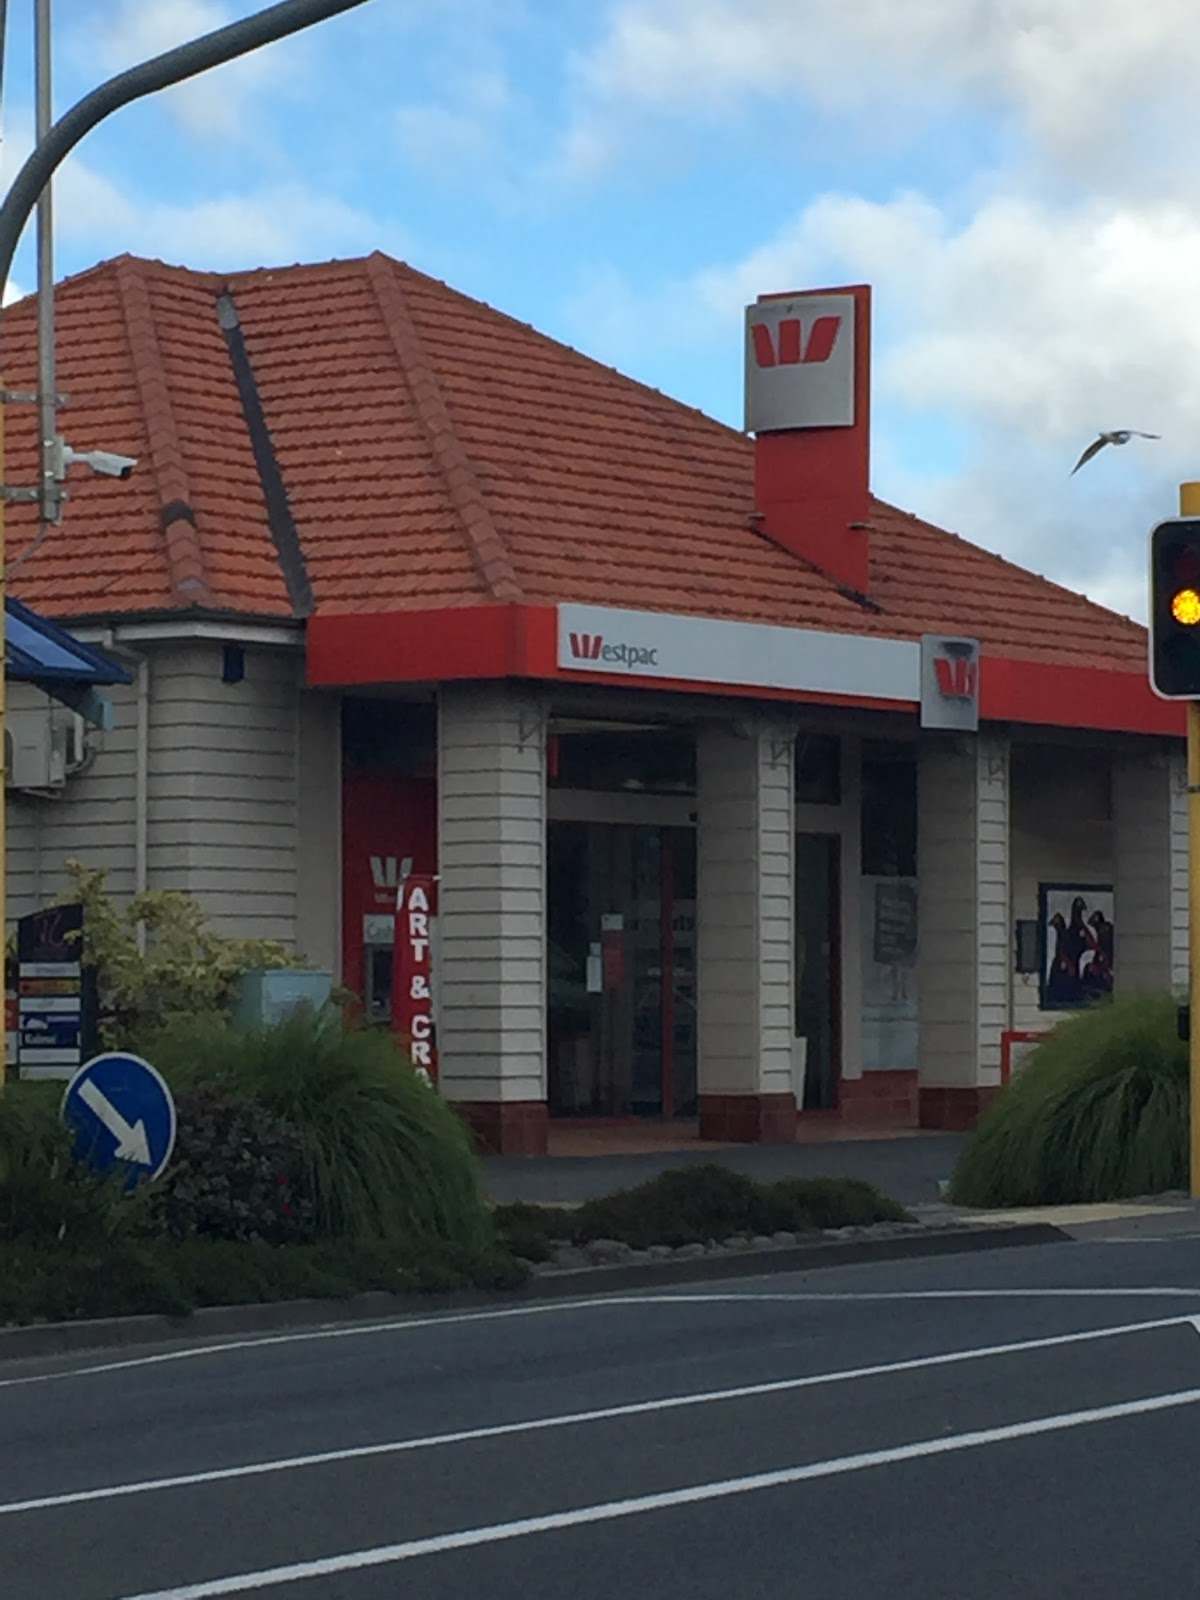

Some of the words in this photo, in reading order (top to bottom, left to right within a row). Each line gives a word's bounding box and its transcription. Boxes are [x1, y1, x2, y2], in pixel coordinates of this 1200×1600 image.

[569, 632, 658, 668] Westpac
[408, 887, 429, 961] ART
[410, 976, 431, 999] &
